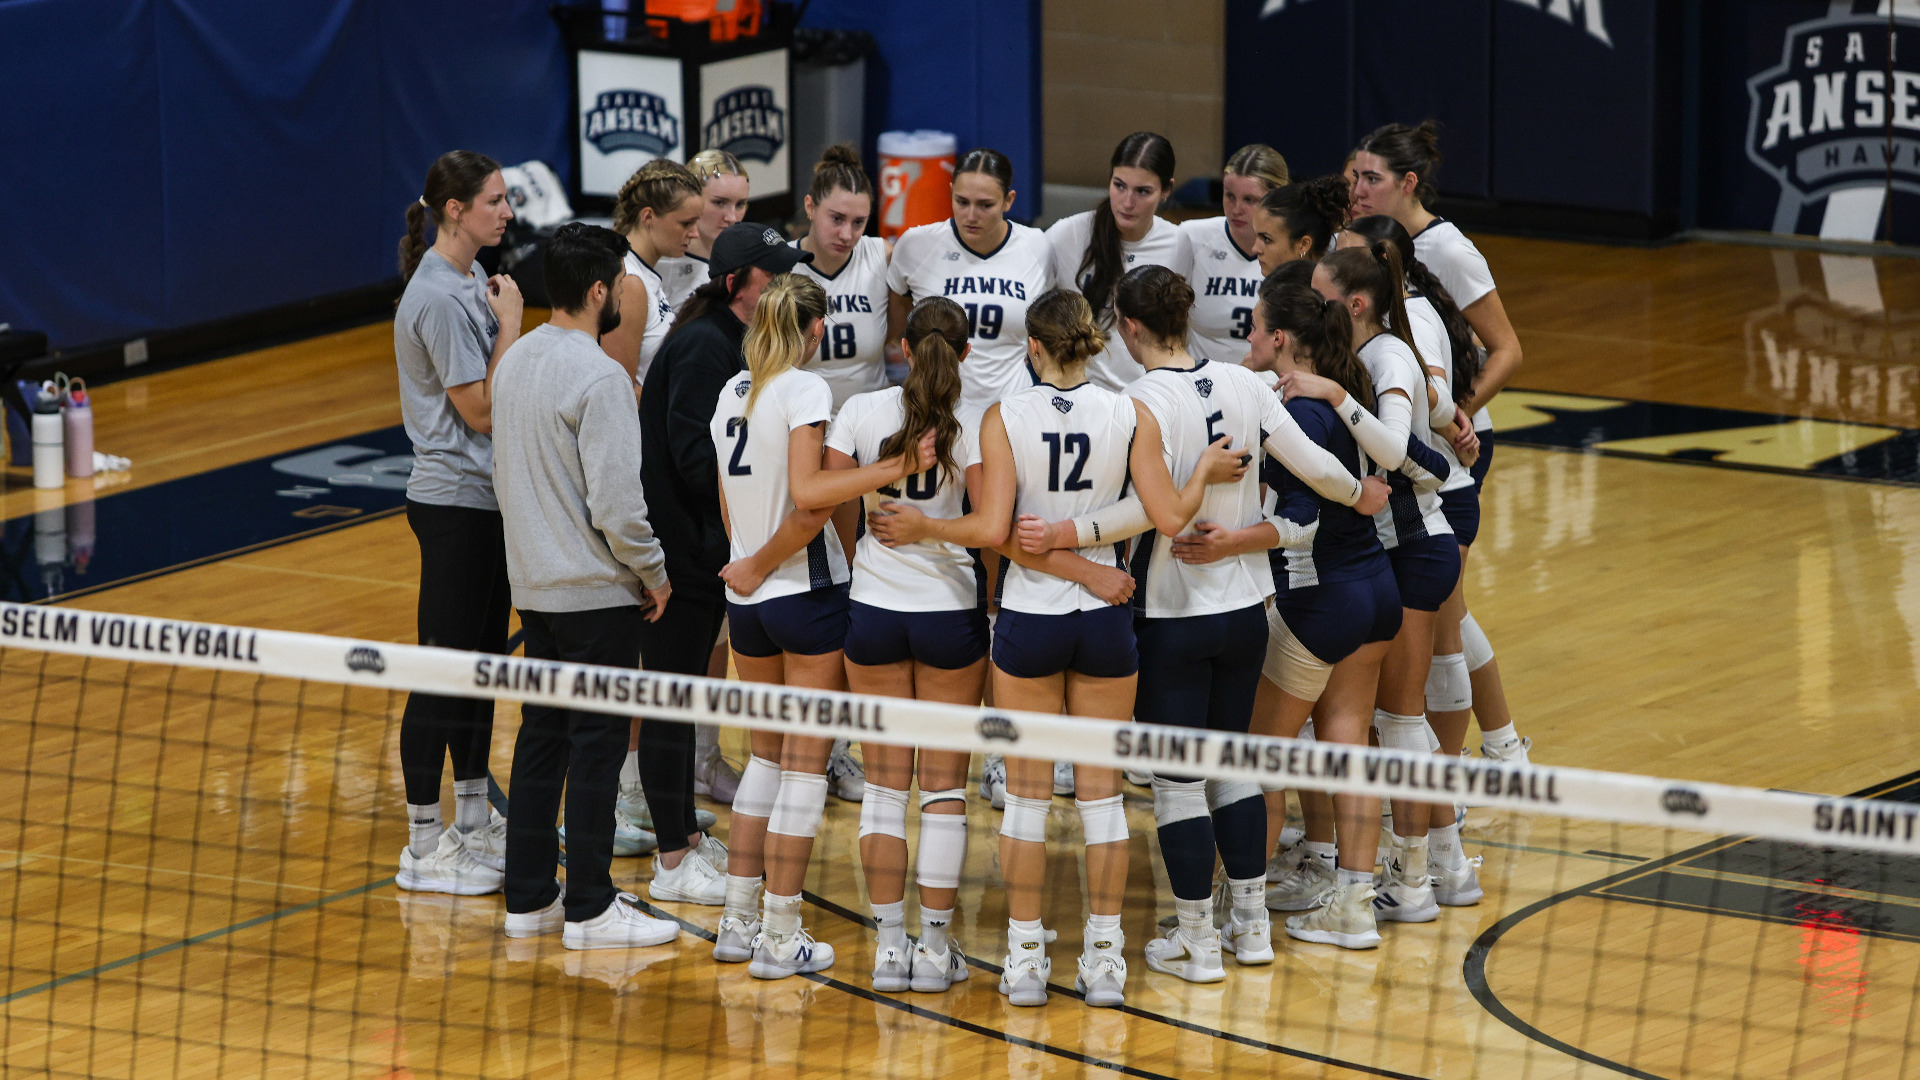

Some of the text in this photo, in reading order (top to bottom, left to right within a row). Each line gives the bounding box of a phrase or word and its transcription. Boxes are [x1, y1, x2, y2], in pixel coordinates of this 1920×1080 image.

[588, 107, 676, 147] ANSELM
[708, 108, 782, 148] ANSELM
[826, 294, 873, 313] WKS
[943, 276, 1027, 302] HAWKS
[1204, 276, 1259, 298] HAW
[964, 303, 1004, 340] 19
[820, 322, 857, 362] 18
[726, 416, 752, 476] 2
[1041, 432, 1094, 492] 12
[1, 608, 260, 663] SELM VOLLEYBALL
[474, 658, 885, 733] SAINT ANSELM VOLLEYBALL
[1114, 728, 1560, 802] SAINT ANSELM VOLLEYBALL
[1813, 801, 1918, 841] SAINT
